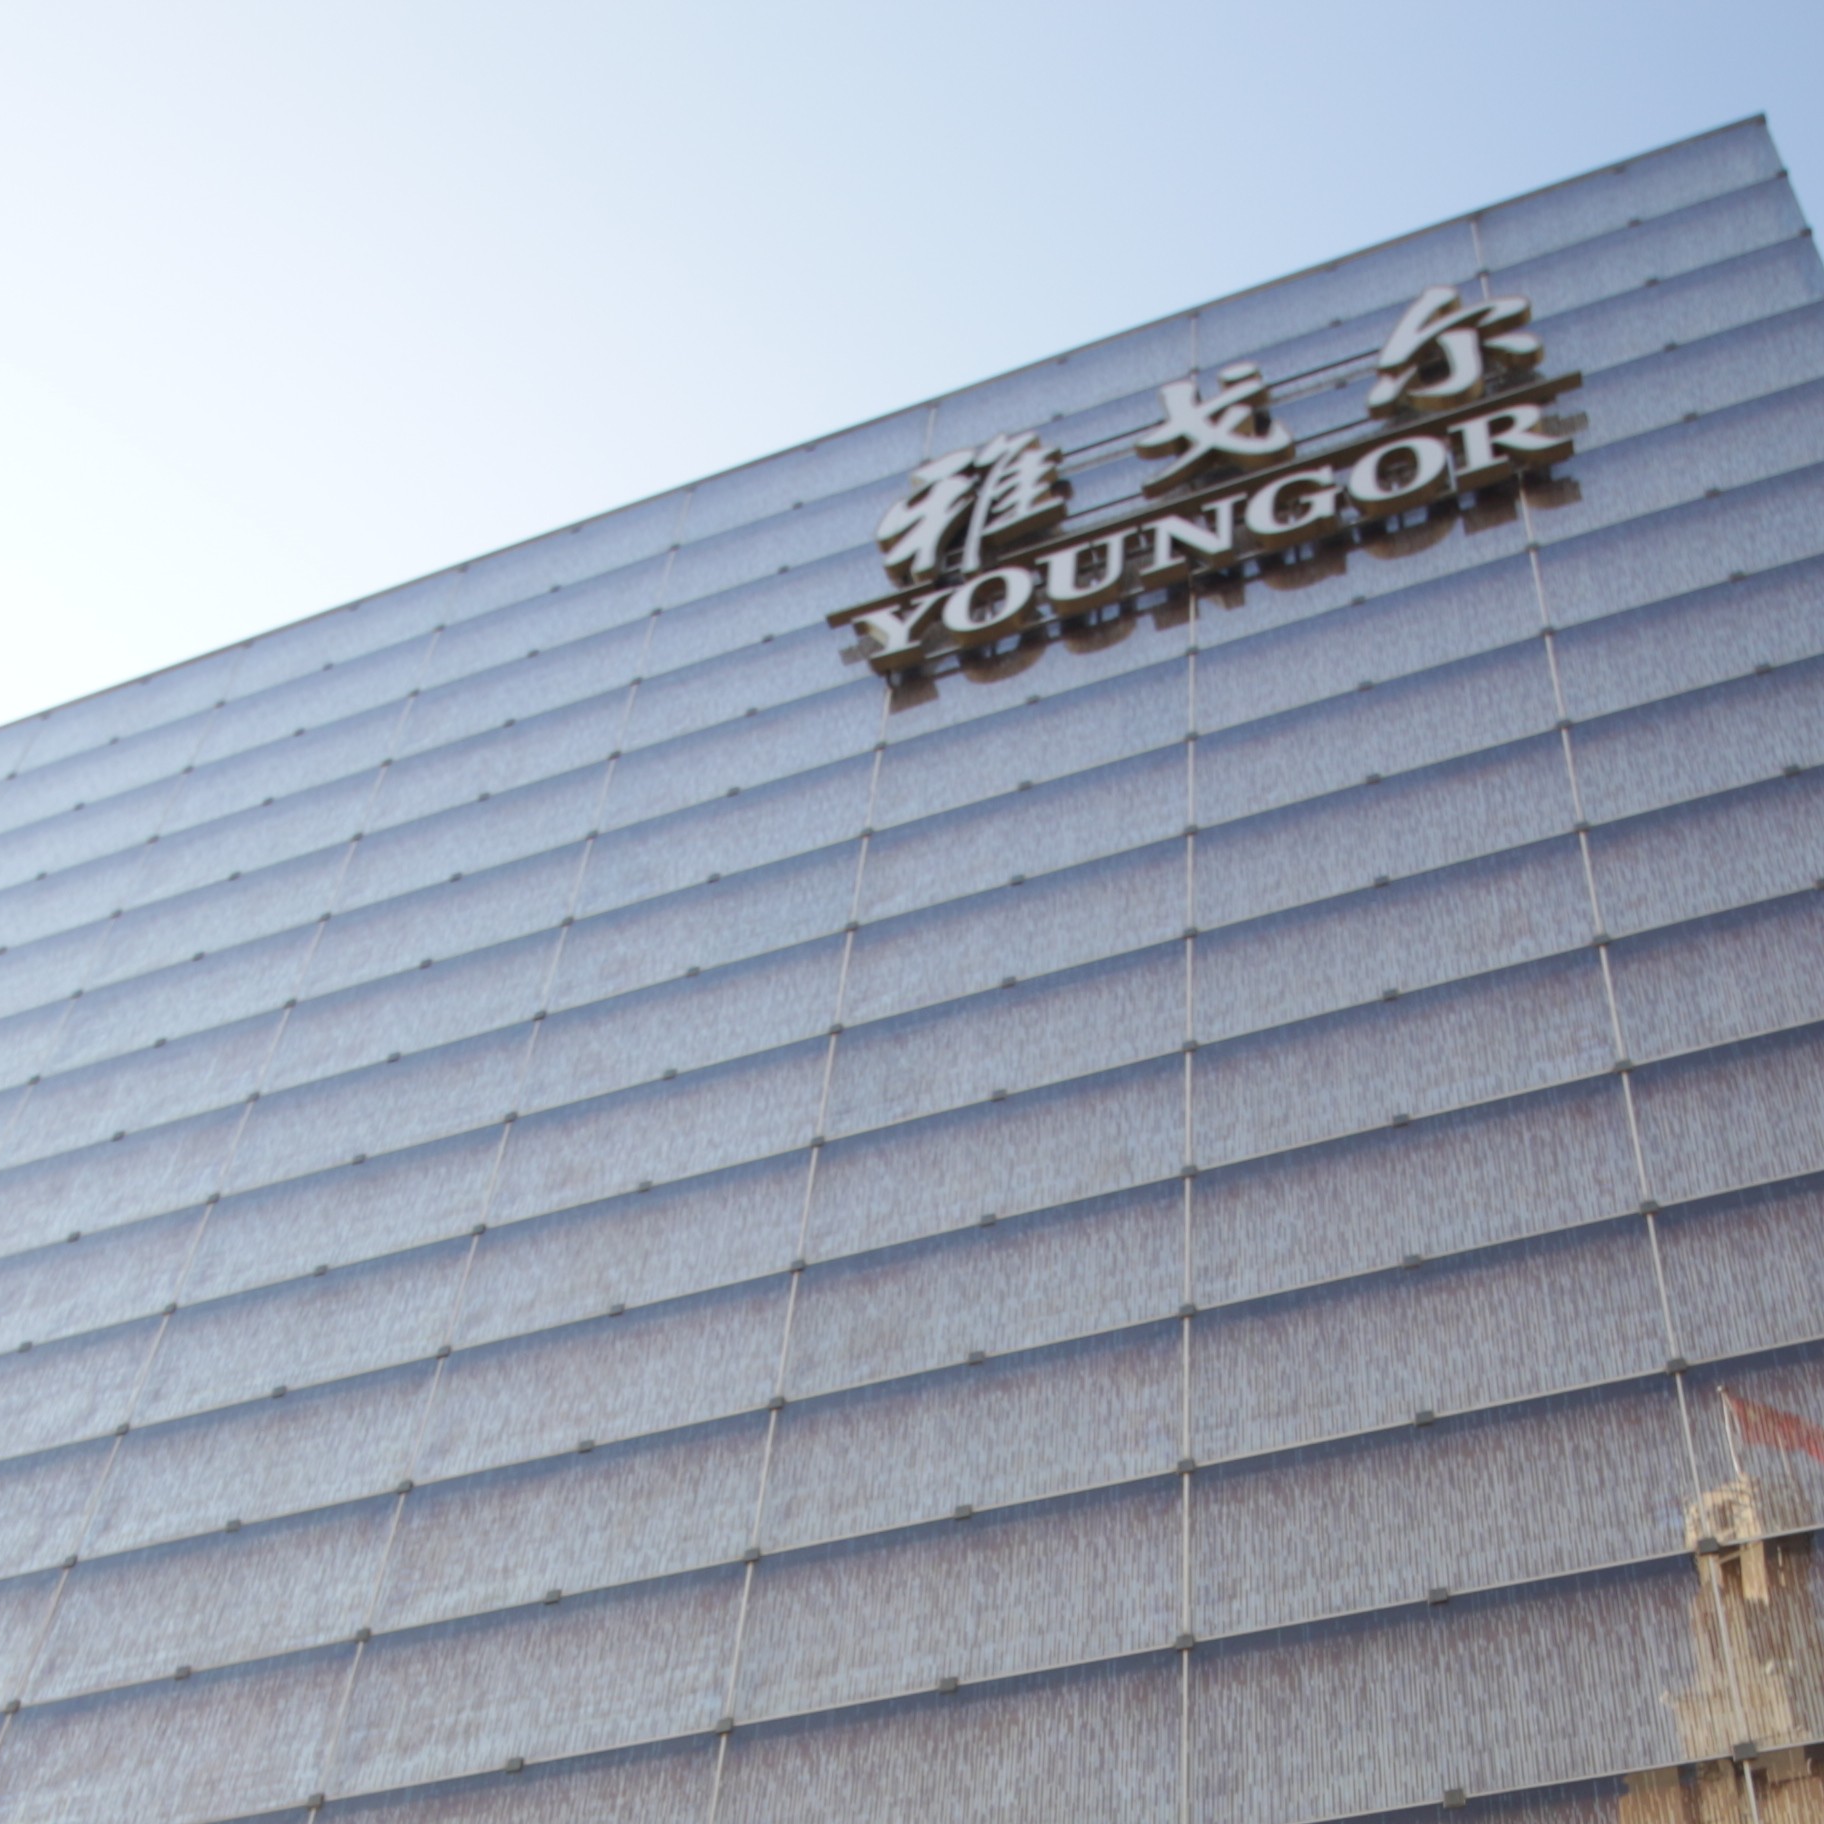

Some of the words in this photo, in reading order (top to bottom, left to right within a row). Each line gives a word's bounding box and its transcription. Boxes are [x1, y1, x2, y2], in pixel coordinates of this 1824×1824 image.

[852, 404, 1571, 662] YOUNGOR
[875, 285, 1544, 578] 雅戈尔
